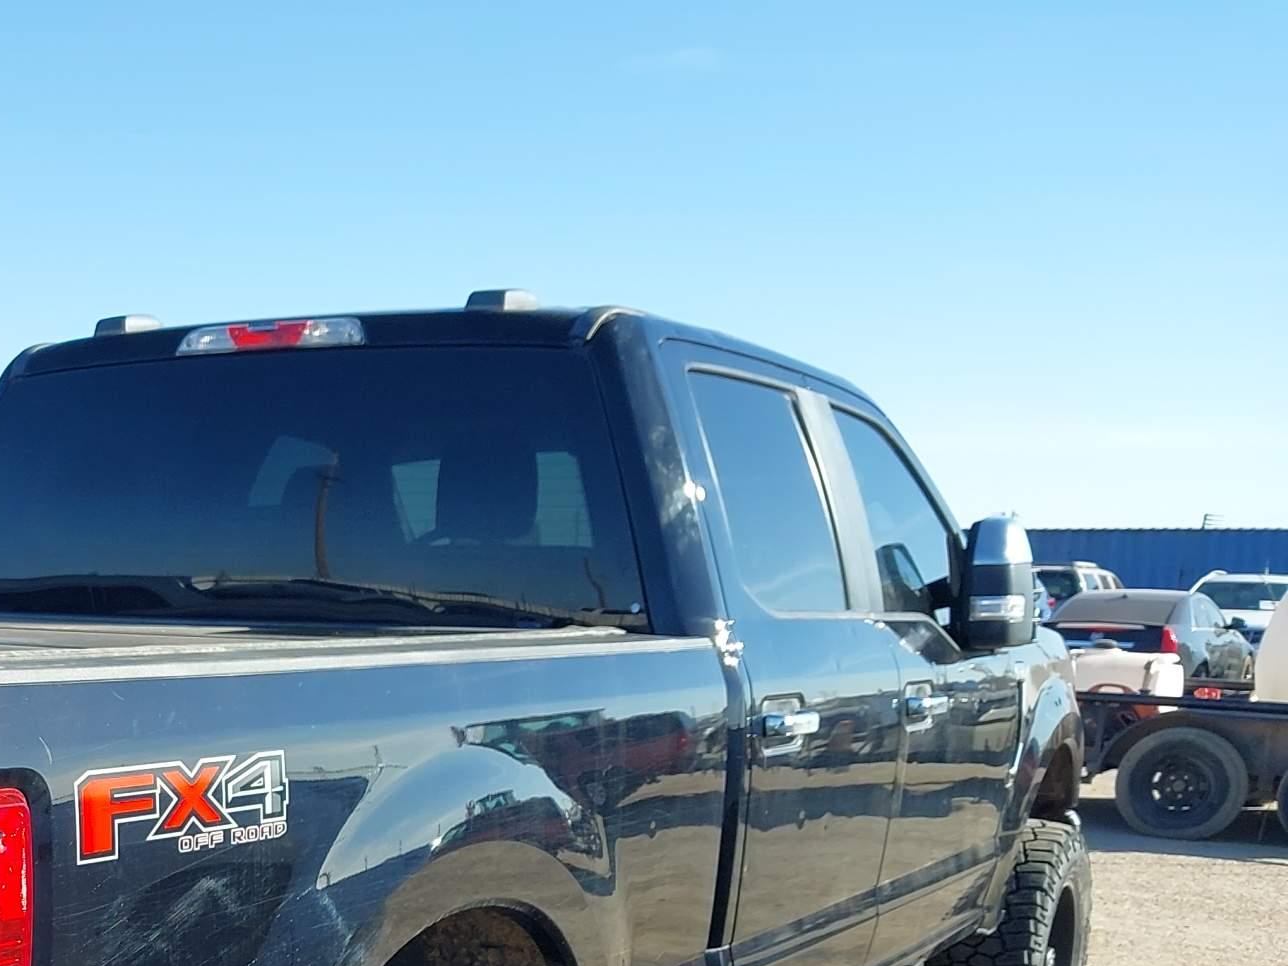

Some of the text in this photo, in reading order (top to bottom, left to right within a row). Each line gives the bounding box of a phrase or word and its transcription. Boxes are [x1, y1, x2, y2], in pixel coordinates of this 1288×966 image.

[73, 749, 289, 866] FX4
[177, 820, 288, 854] OFF ROAD
